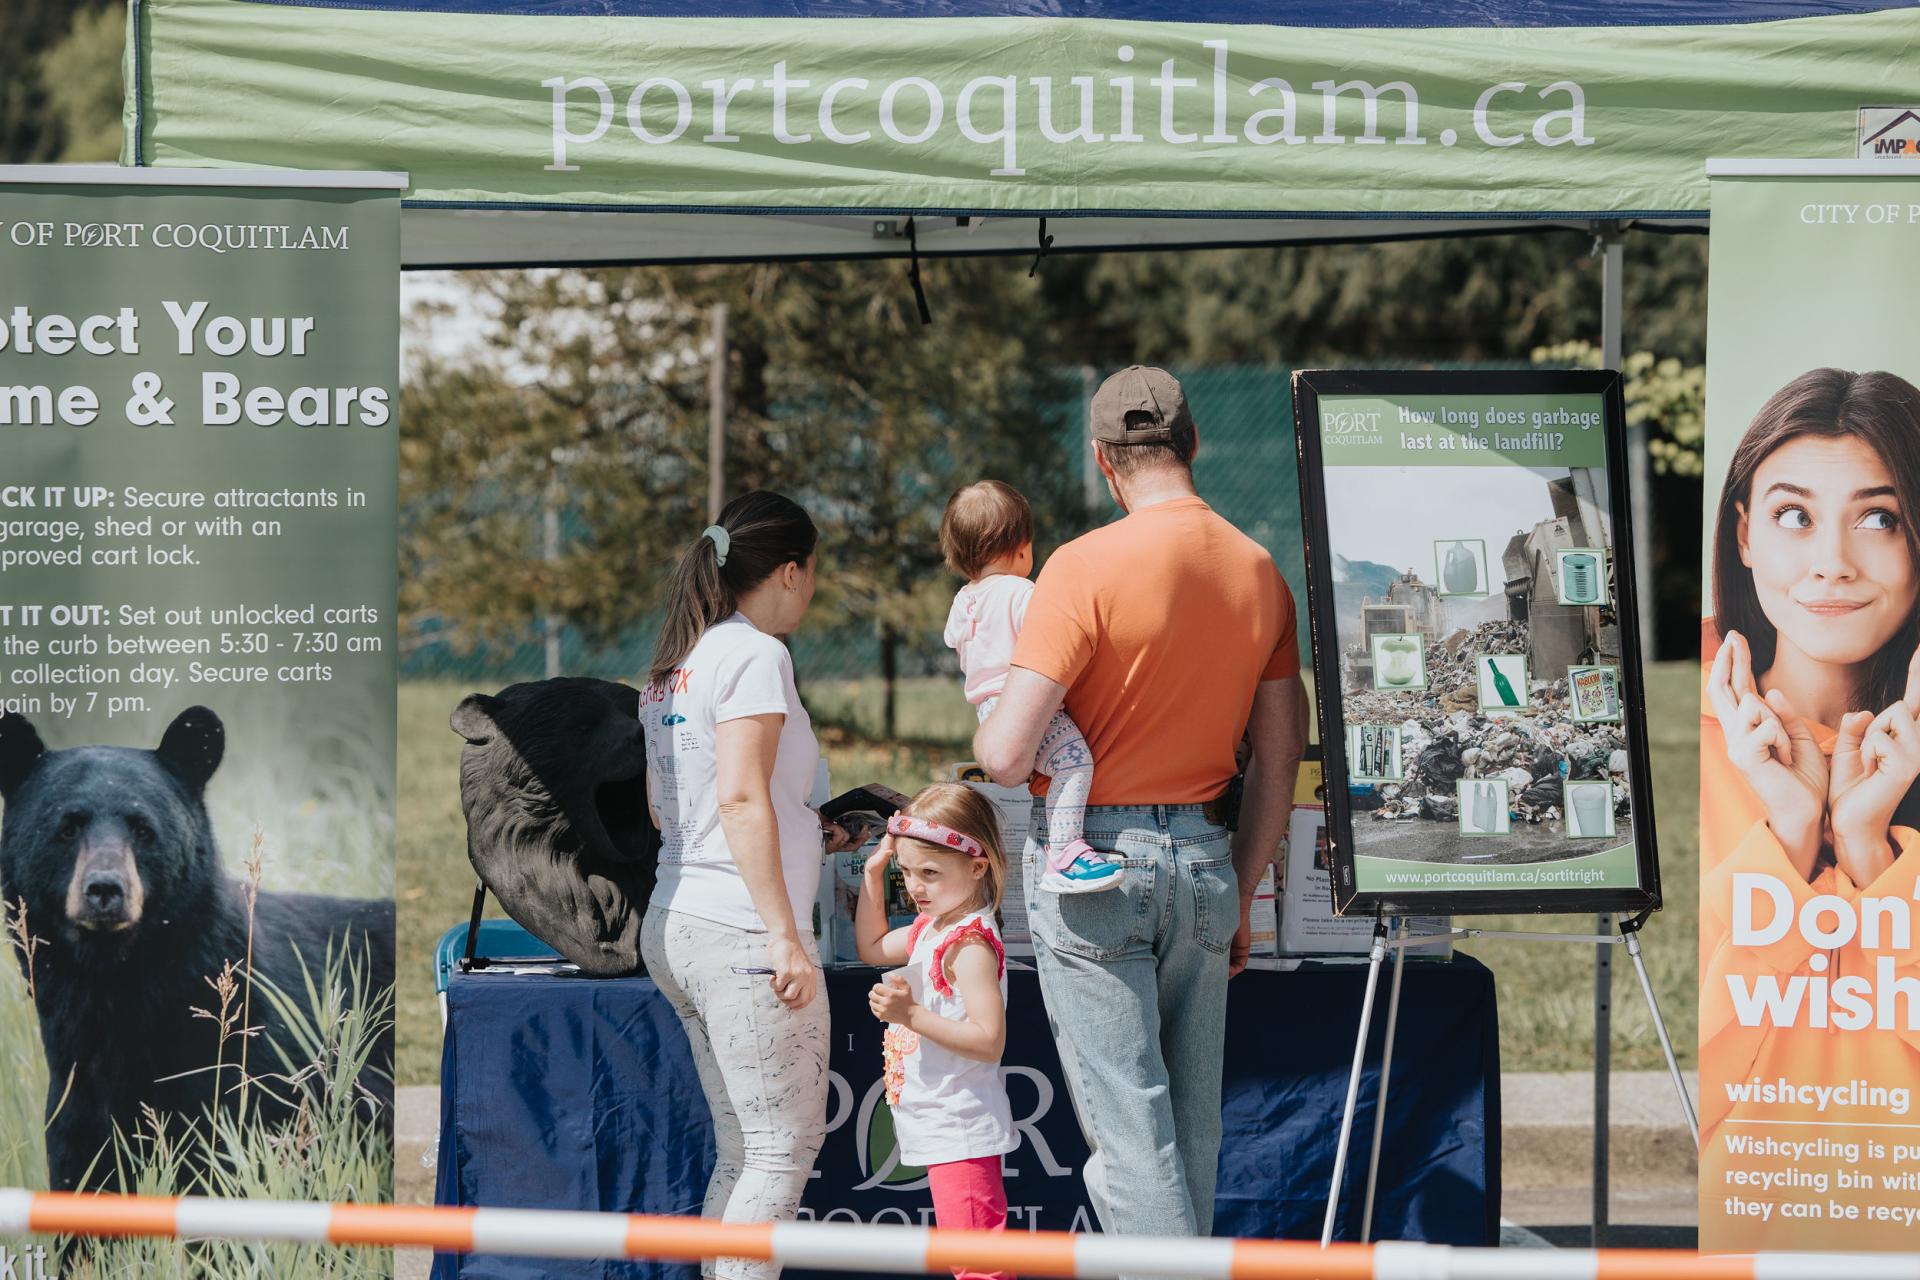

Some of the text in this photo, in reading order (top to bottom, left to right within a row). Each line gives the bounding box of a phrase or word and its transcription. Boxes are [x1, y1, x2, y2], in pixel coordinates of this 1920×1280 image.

[541, 39, 1596, 176] portcoquitlam.ca
[1800, 204, 1860, 224] CITY
[1865, 204, 1900, 224] OF
[11, 221, 54, 246] OF
[64, 222, 144, 248] PORT
[152, 224, 349, 253] COQUITLAM
[0, 300, 315, 356] tect Your
[125, 371, 175, 426] &
[202, 371, 390, 426] Bears
[1323, 412, 1382, 434] PORT
[1399, 406, 1601, 431] How long does garbage
[1325, 435, 1383, 445] COQUITLAM
[1400, 432, 1565, 451] last at the landfill?
[0, 486, 366, 508] CK IT UP: Secure attractants in
[94, 516, 152, 537] shed
[161, 519, 188, 537] or
[195, 515, 243, 537] with
[252, 517, 281, 536] an
[91, 546, 138, 566] cart
[147, 544, 200, 566] lock.
[21, 605, 43, 626] IT
[51, 604, 110, 626] OUT:
[119, 605, 156, 626] Set
[165, 605, 202, 625] out
[211, 603, 314, 625] unlocked
[323, 604, 378, 624] carts
[4, 634, 40, 655] the
[48, 634, 98, 655] curb
[108, 633, 210, 655] between
[220, 633, 269, 654] 5:30
[292, 632, 338, 653] 7:30
[346, 636, 382, 652] am
[11, 663, 119, 685] collection
[129, 662, 179, 688] day.
[188, 662, 269, 683] Secure
[277, 662, 332, 682] carts
[50, 693, 76, 718] by
[86, 692, 98, 713] 7
[108, 695, 151, 718] pm.
[1385, 868, 1605, 887] www.portcoquitlam.ca/sortitright
[1725, 953, 1920, 1031] wish
[1725, 1076, 1910, 1114] wishcycling
[1725, 1135, 1860, 1164] Wishcycling
[1867, 1140, 1885, 1159] is
[1725, 1168, 1828, 1193] recycling
[1837, 1169, 1873, 1189] bin
[1725, 1197, 1774, 1221] they
[1780, 1202, 1822, 1218] can
[1829, 1200, 1860, 1219] be
